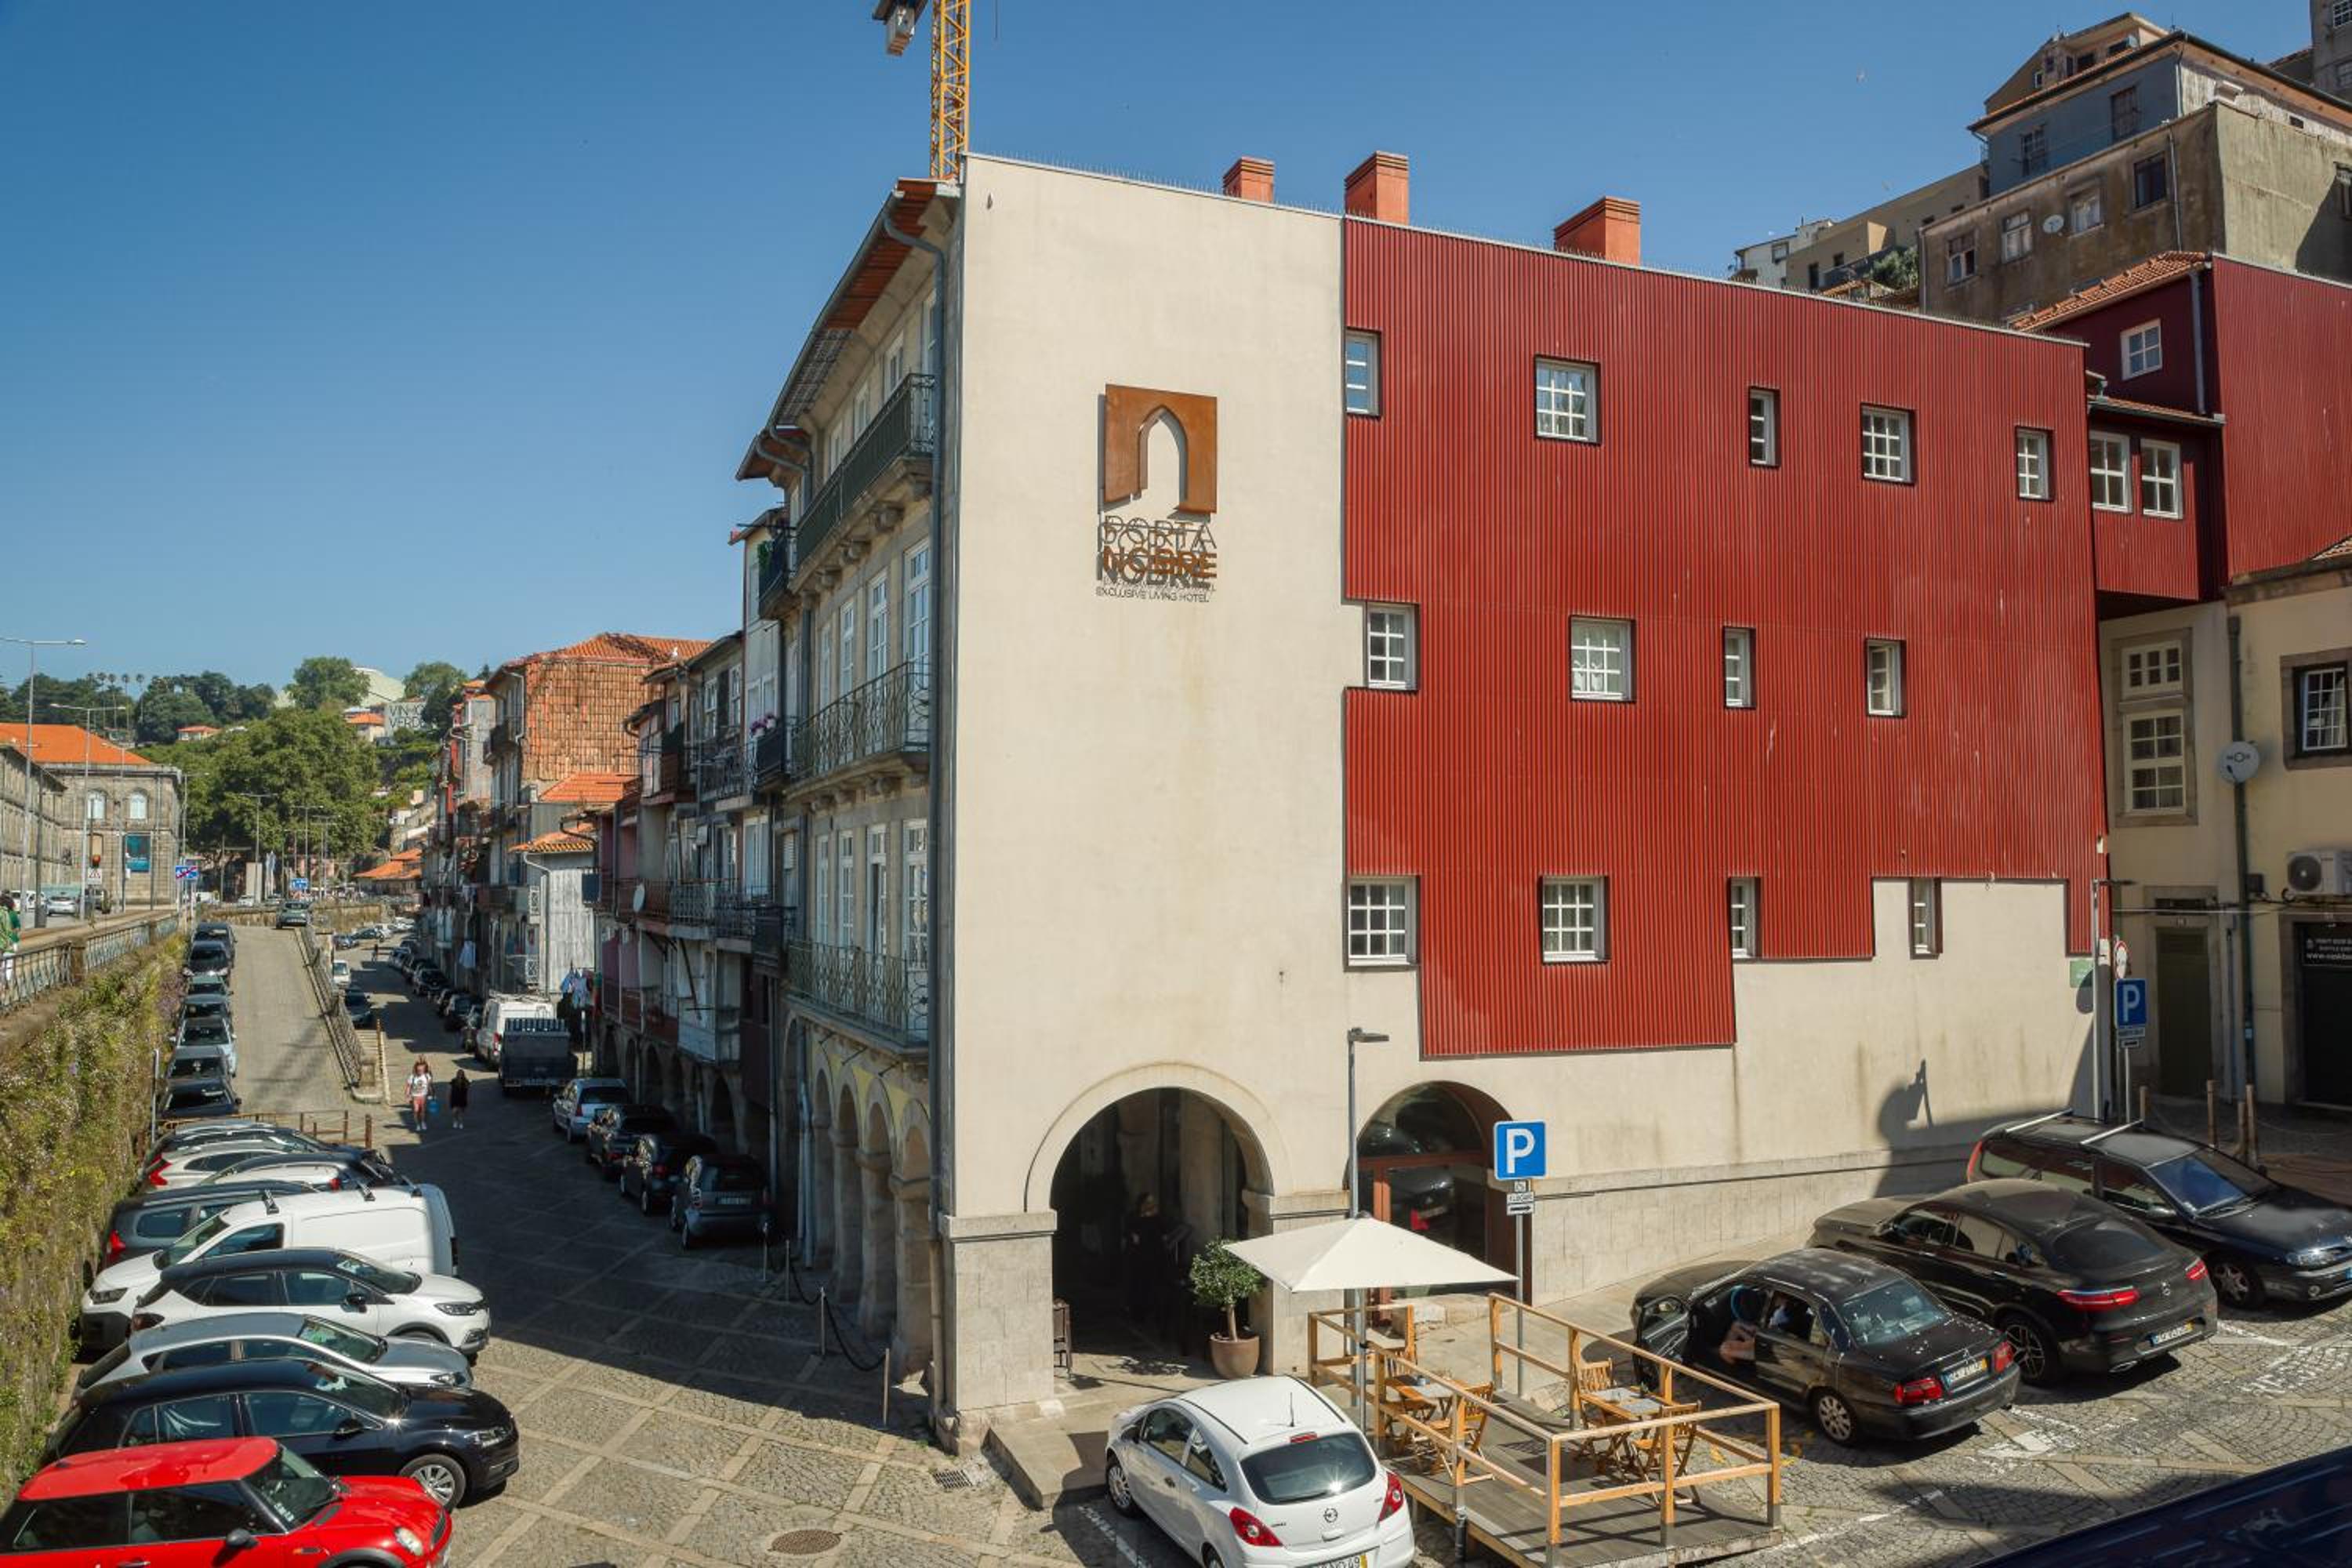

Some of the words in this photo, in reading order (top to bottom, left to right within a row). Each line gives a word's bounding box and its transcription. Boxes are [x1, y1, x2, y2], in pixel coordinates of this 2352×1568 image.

[1102, 515, 1218, 550] PORTA
[1102, 546, 1218, 580] NOBRE
[1095, 587, 1146, 601] EXCLUSIVE
[1149, 591, 1177, 602] LIVING
[1178, 593, 1210, 603] HOTEL
[2123, 985, 2140, 1022] P
[1506, 1129, 1535, 1174] P
